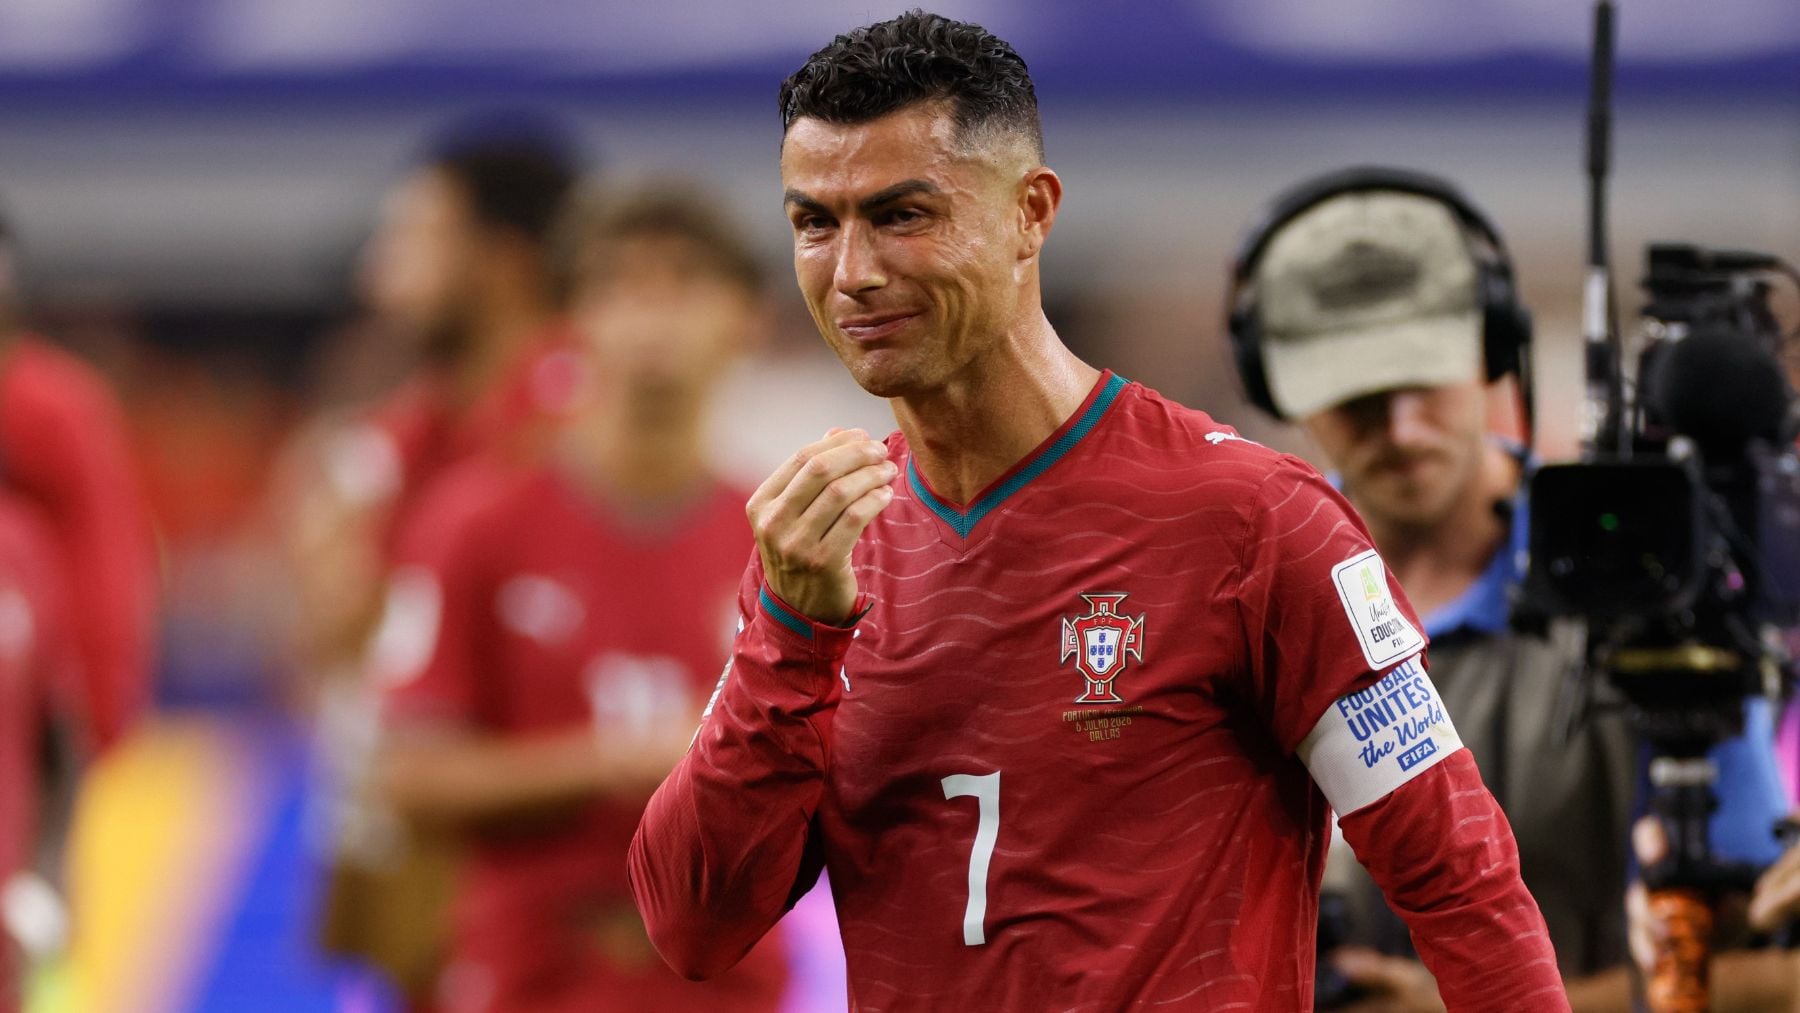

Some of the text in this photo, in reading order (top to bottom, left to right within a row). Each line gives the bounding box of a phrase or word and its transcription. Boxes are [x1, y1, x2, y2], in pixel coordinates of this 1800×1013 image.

[1093, 618, 1113, 626] FPF
[1336, 661, 1418, 718] FOOTBALL
[1347, 677, 1431, 742] UNITES
[1076, 721, 1082, 732] 6
[1111, 716, 1132, 728] 2026
[1089, 728, 1121, 742] DALLAS
[1358, 701, 1445, 769] the World
[1399, 741, 1436, 769] FIFA
[941, 770, 1001, 946] 7
